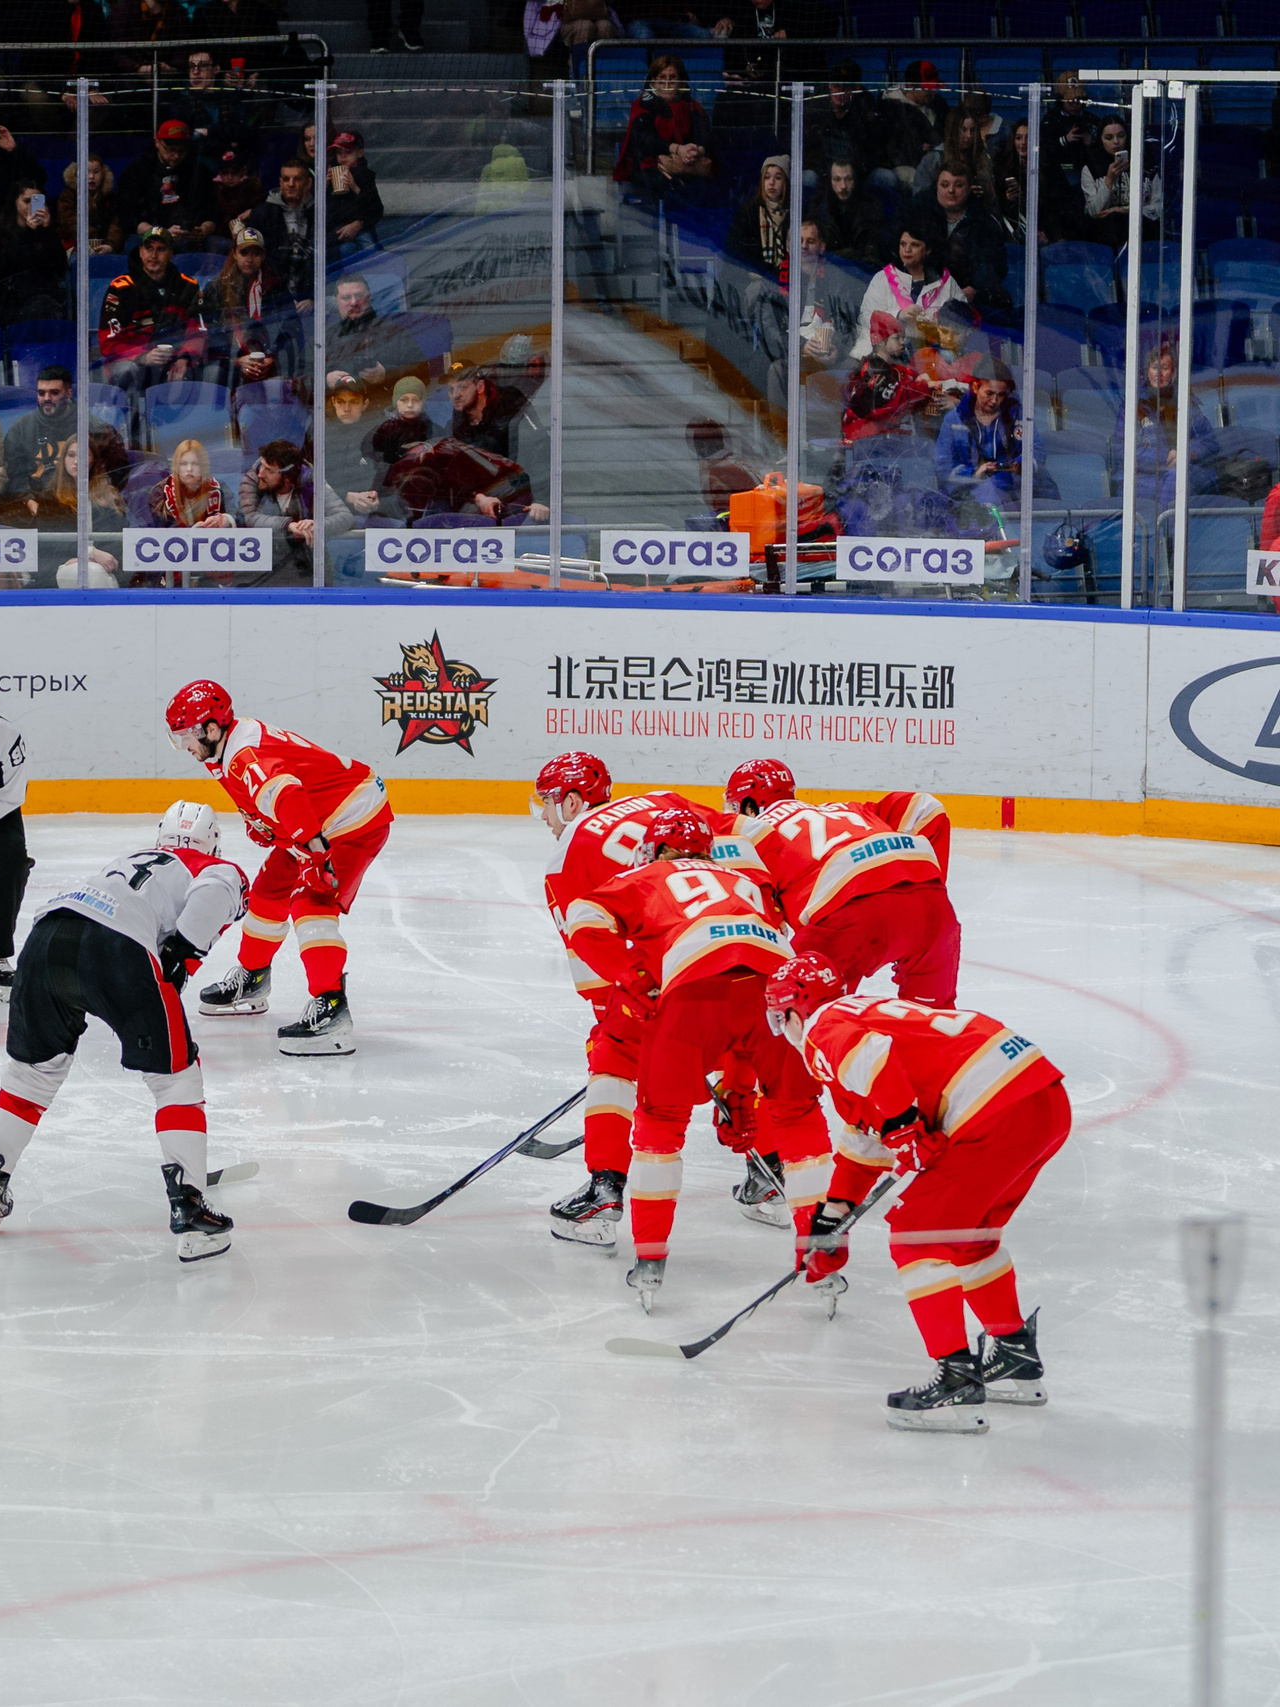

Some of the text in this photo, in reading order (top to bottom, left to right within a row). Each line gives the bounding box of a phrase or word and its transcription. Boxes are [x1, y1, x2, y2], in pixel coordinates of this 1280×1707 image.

[547, 655, 955, 710] 北京昆仑鸿星冰球俱乐部
[547, 708, 955, 745] BEIJING KUNLUN RED STAR HOCKEY CLUB
[243, 763, 268, 797] 21
[778, 770, 790, 782] 27
[584, 797, 657, 836] PAIGIN
[850, 836, 915, 863] SIBUR
[710, 923, 778, 944] SIBUR
[1000, 1036, 1036, 1060] SIB
